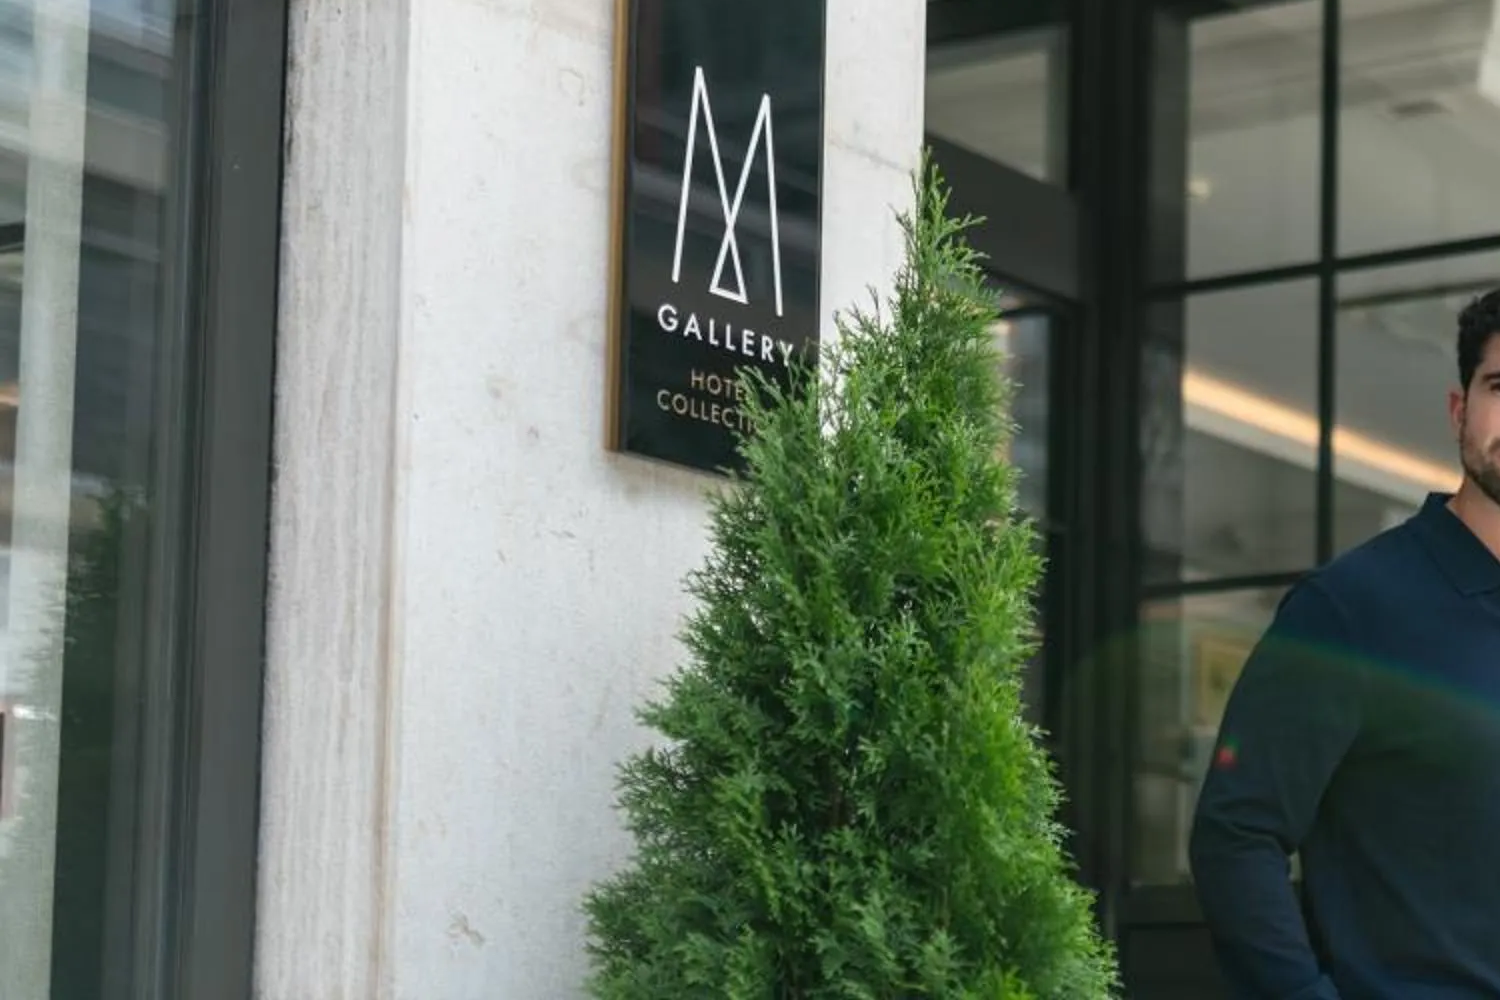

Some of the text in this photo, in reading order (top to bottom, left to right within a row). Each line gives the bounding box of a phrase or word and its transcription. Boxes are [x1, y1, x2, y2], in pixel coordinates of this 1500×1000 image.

[657, 303, 793, 367] GALLERY
[691, 368, 750, 401] HOTE
[656, 388, 762, 436] COLLECTI
